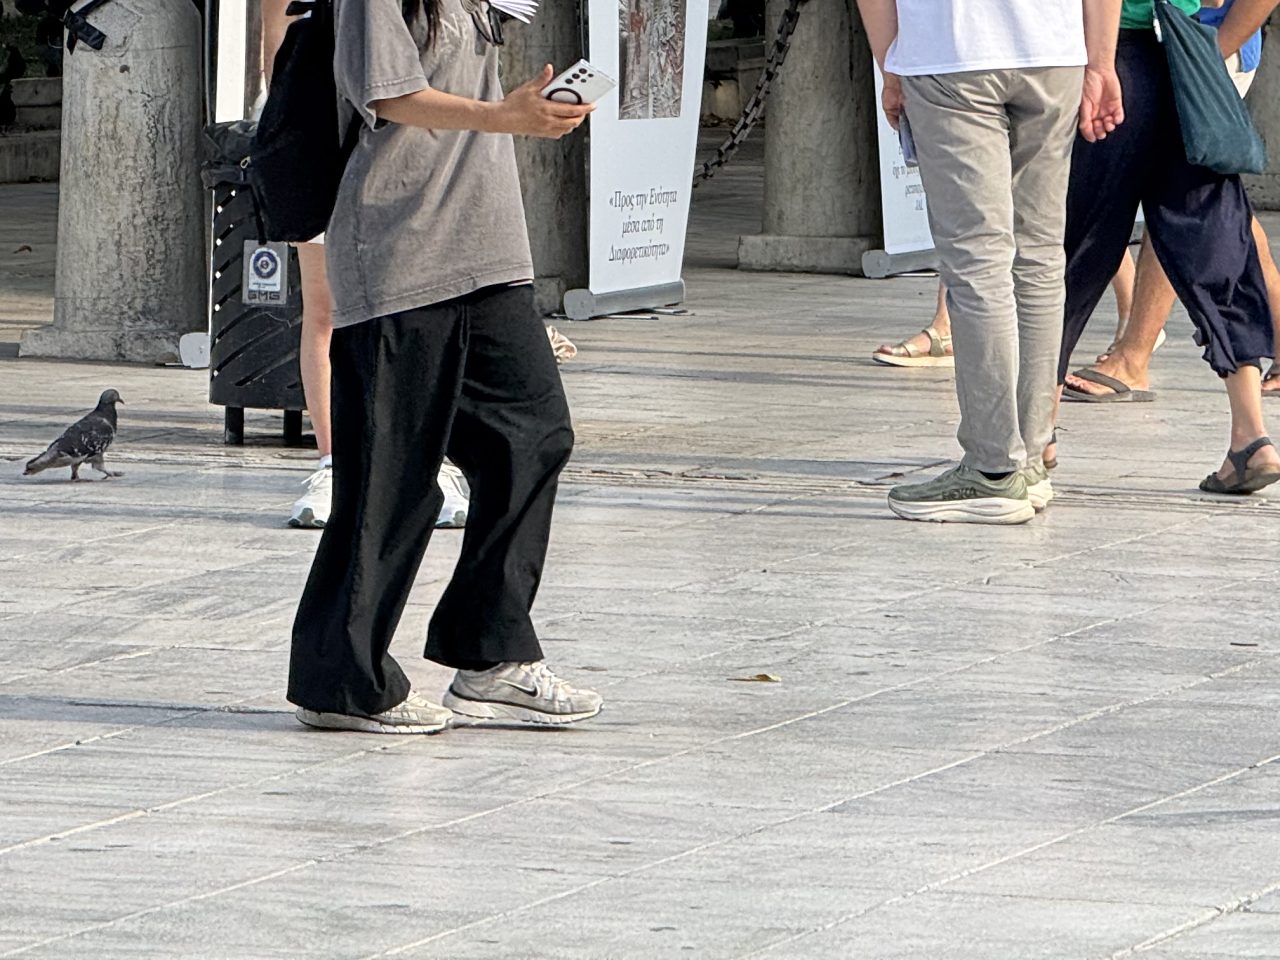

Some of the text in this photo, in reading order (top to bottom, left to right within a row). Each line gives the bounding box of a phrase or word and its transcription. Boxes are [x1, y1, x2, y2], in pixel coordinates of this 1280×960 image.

[609, 186, 678, 211] «Προς την Ενότητα
[622, 212, 664, 238] μέσα από τη
